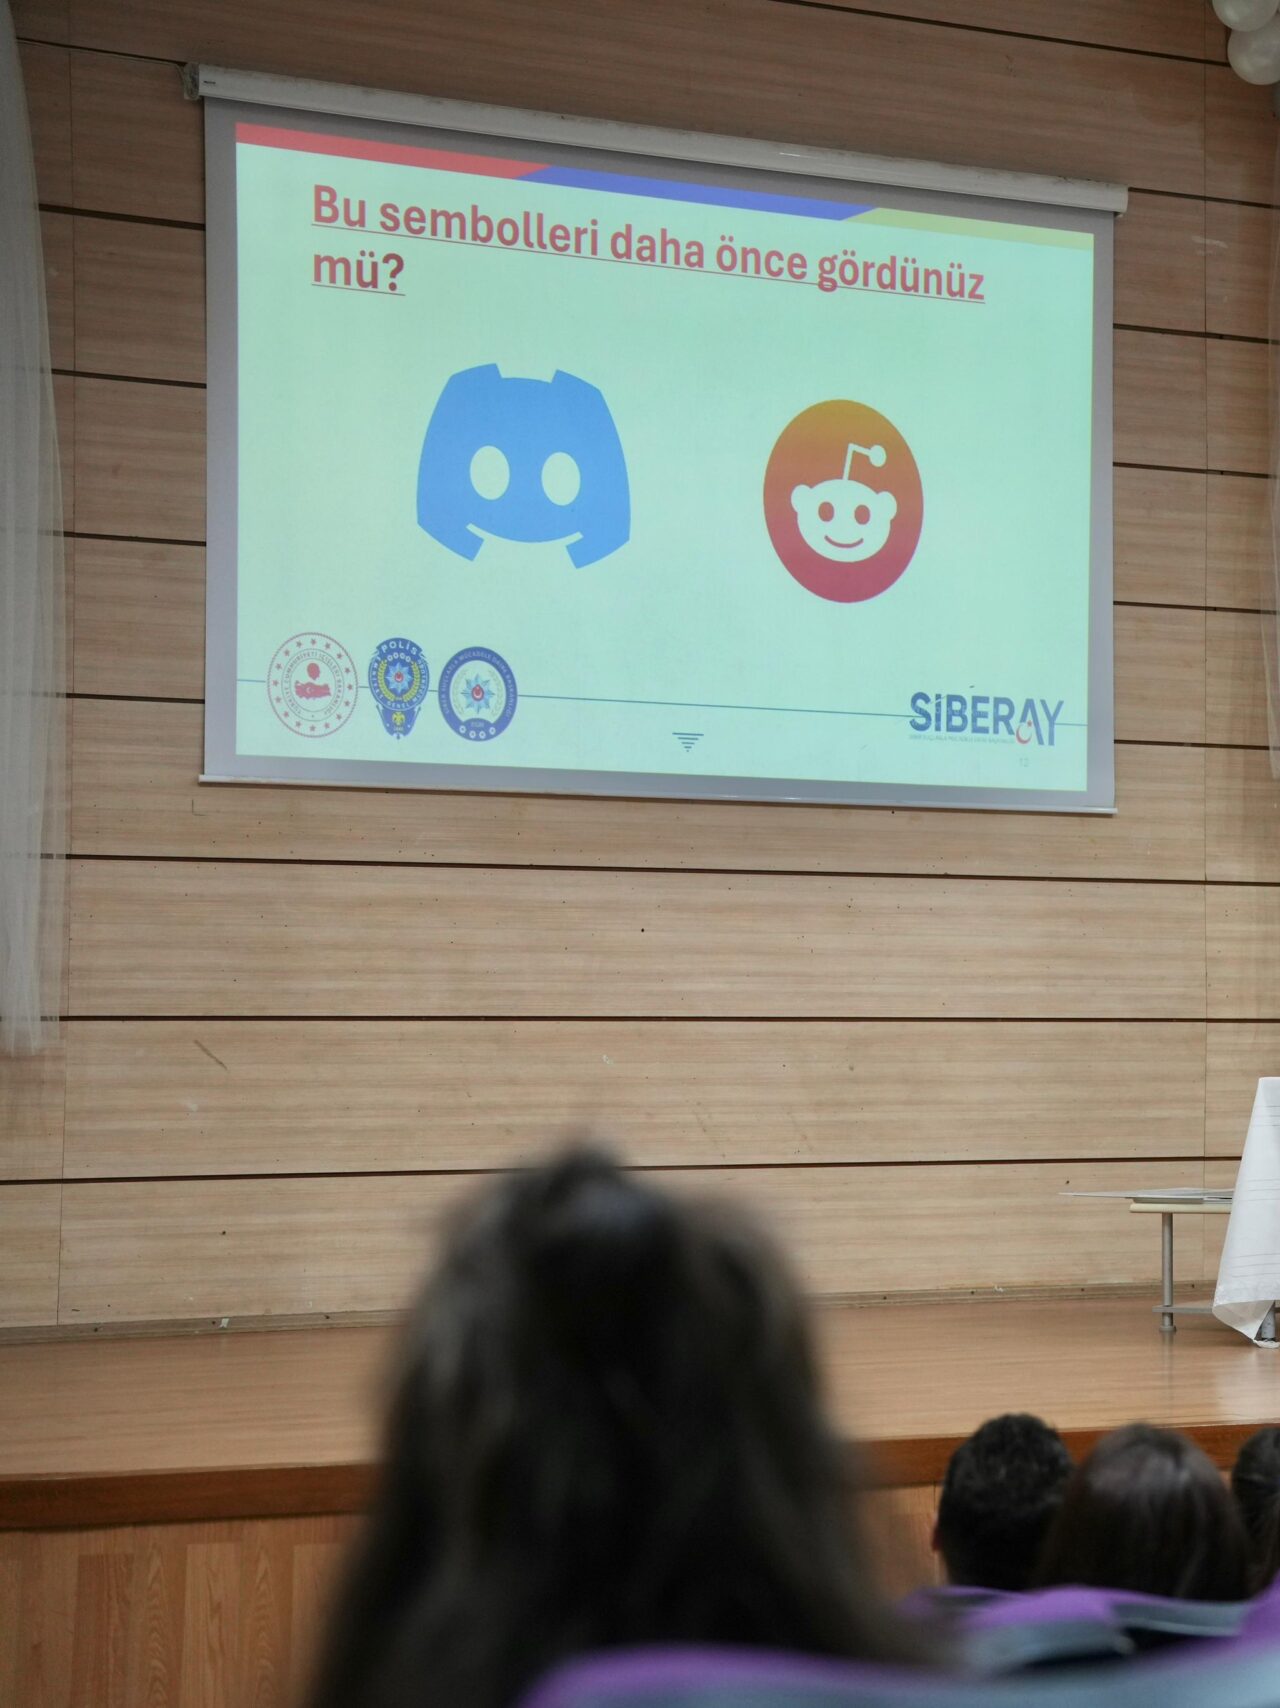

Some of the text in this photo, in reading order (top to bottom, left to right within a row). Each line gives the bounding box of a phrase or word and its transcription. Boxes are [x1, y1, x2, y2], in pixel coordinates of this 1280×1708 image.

[314, 184, 985, 300] Bu sembolleri daha önce gördünüz
[314, 250, 405, 290] mü?
[381, 640, 418, 656] POLİS
[909, 691, 1064, 746] SİBERAY
